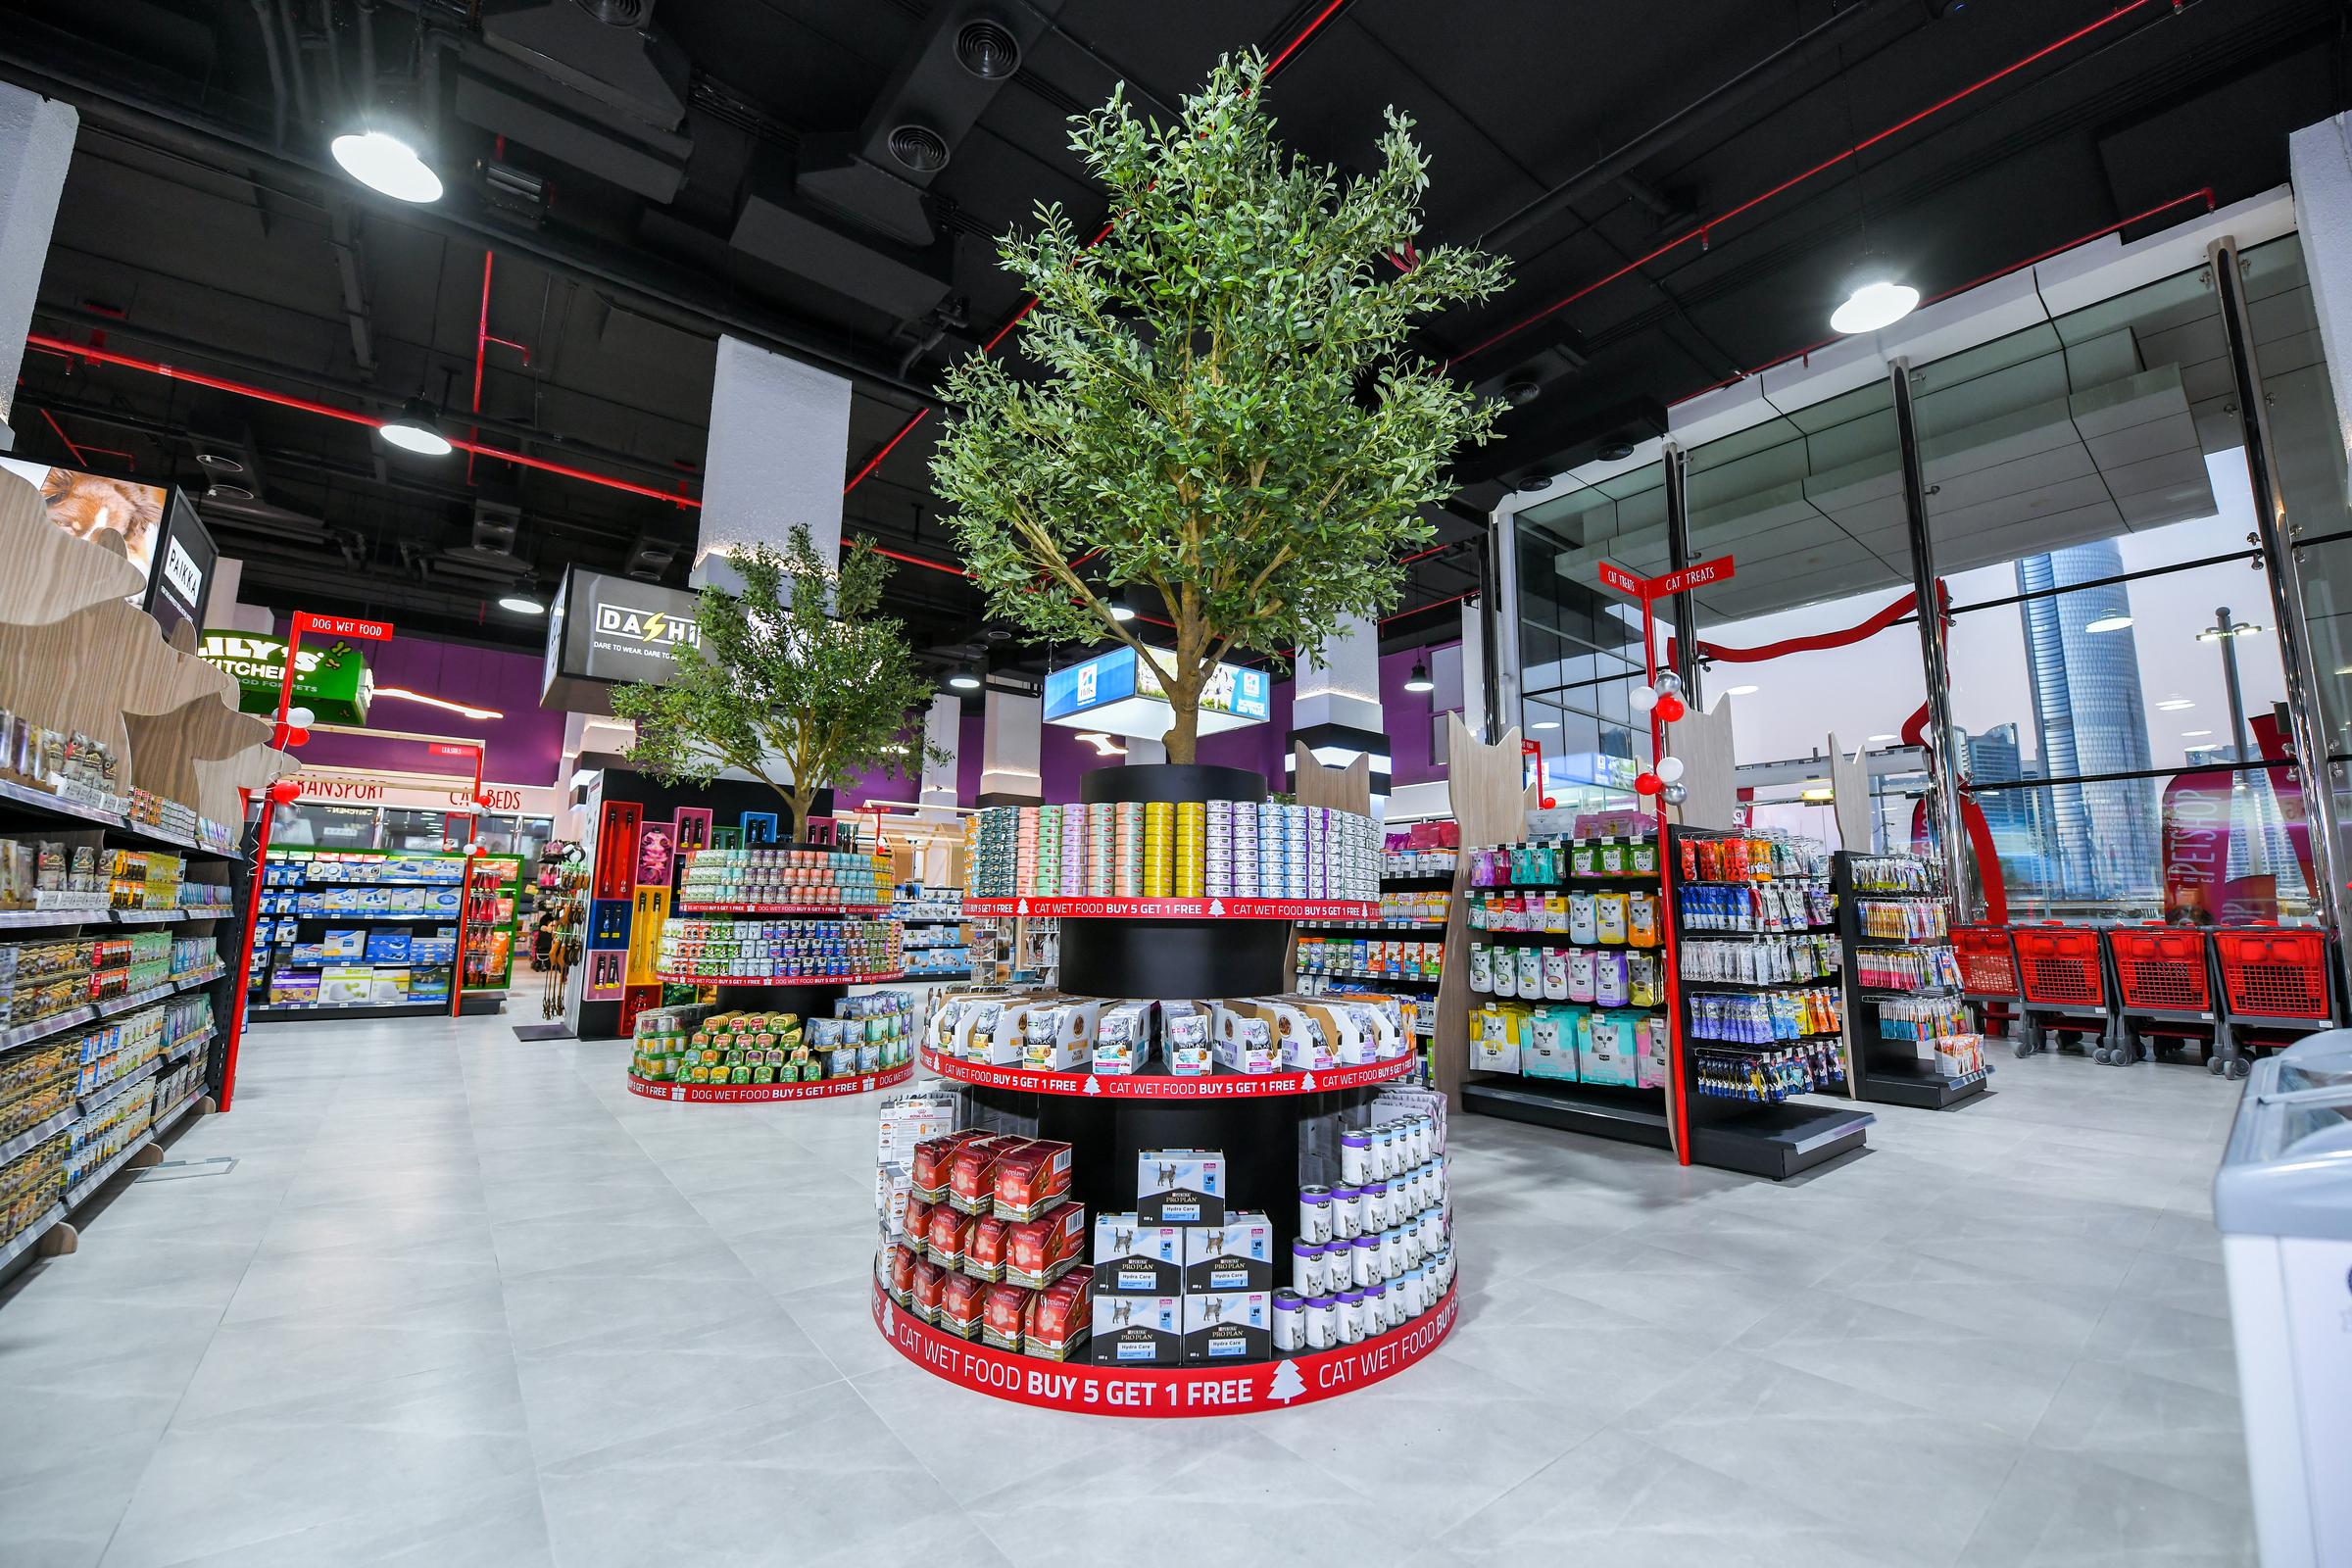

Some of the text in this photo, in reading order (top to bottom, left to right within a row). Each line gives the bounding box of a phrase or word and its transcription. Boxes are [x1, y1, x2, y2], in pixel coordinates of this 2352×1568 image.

[169, 549, 196, 596] PAIKKA
[1607, 570, 1635, 592] CAT TREATS
[1666, 566, 1715, 591] CAT TREATS
[312, 618, 382, 636] DOG WET FOOD
[594, 641, 612, 650] DARE
[291, 773, 385, 800] RANSPORT
[487, 789, 520, 810] BEDS
[2168, 789, 2221, 876] PETSHOP
[981, 904, 991, 912] GET
[997, 904, 1012, 912] FREE
[1035, 904, 1201, 914] CAT WET FOOD BUY 5 GET 1 FREE
[1233, 905, 1251, 914] CAT
[1254, 905, 1276, 915] WET
[1278, 906, 1302, 915] FOOD
[1304, 906, 1320, 916] BUY
[1322, 906, 1327, 916] 5
[1328, 907, 1342, 916] GET
[1347, 907, 1359, 916] FREE
[879, 1074, 893, 1086] DOG
[893, 1071, 904, 1081] WET
[945, 1063, 1076, 1092] CAT WET FOOD BUY 5 GET 1 FREE
[1322, 1075, 1339, 1088] CAT
[1340, 1073, 1357, 1085] WET
[1358, 1069, 1378, 1082] FOOD
[1378, 1066, 1390, 1078] BUY
[1390, 1065, 1394, 1075] 5
[1394, 1063, 1402, 1074] GET
[636, 1083, 645, 1093] GET
[650, 1086, 666, 1096] FREE
[691, 1082, 858, 1100] DOG WET FOOD BUY 5 GET 1 FREE
[1109, 1079, 1296, 1095] CAT WET FOOD BUY 5 GET 1 FREE
[1004, 1168, 1025, 1177] Applaws
[1319, 1358, 1356, 1389] CAT
[1360, 1342, 1398, 1376] WET
[1401, 1321, 1435, 1360] FOOD
[1436, 1305, 1451, 1336] BUY
[900, 1323, 1253, 1406] CAT WET FOOD BUY 5 GET 1 FREE
